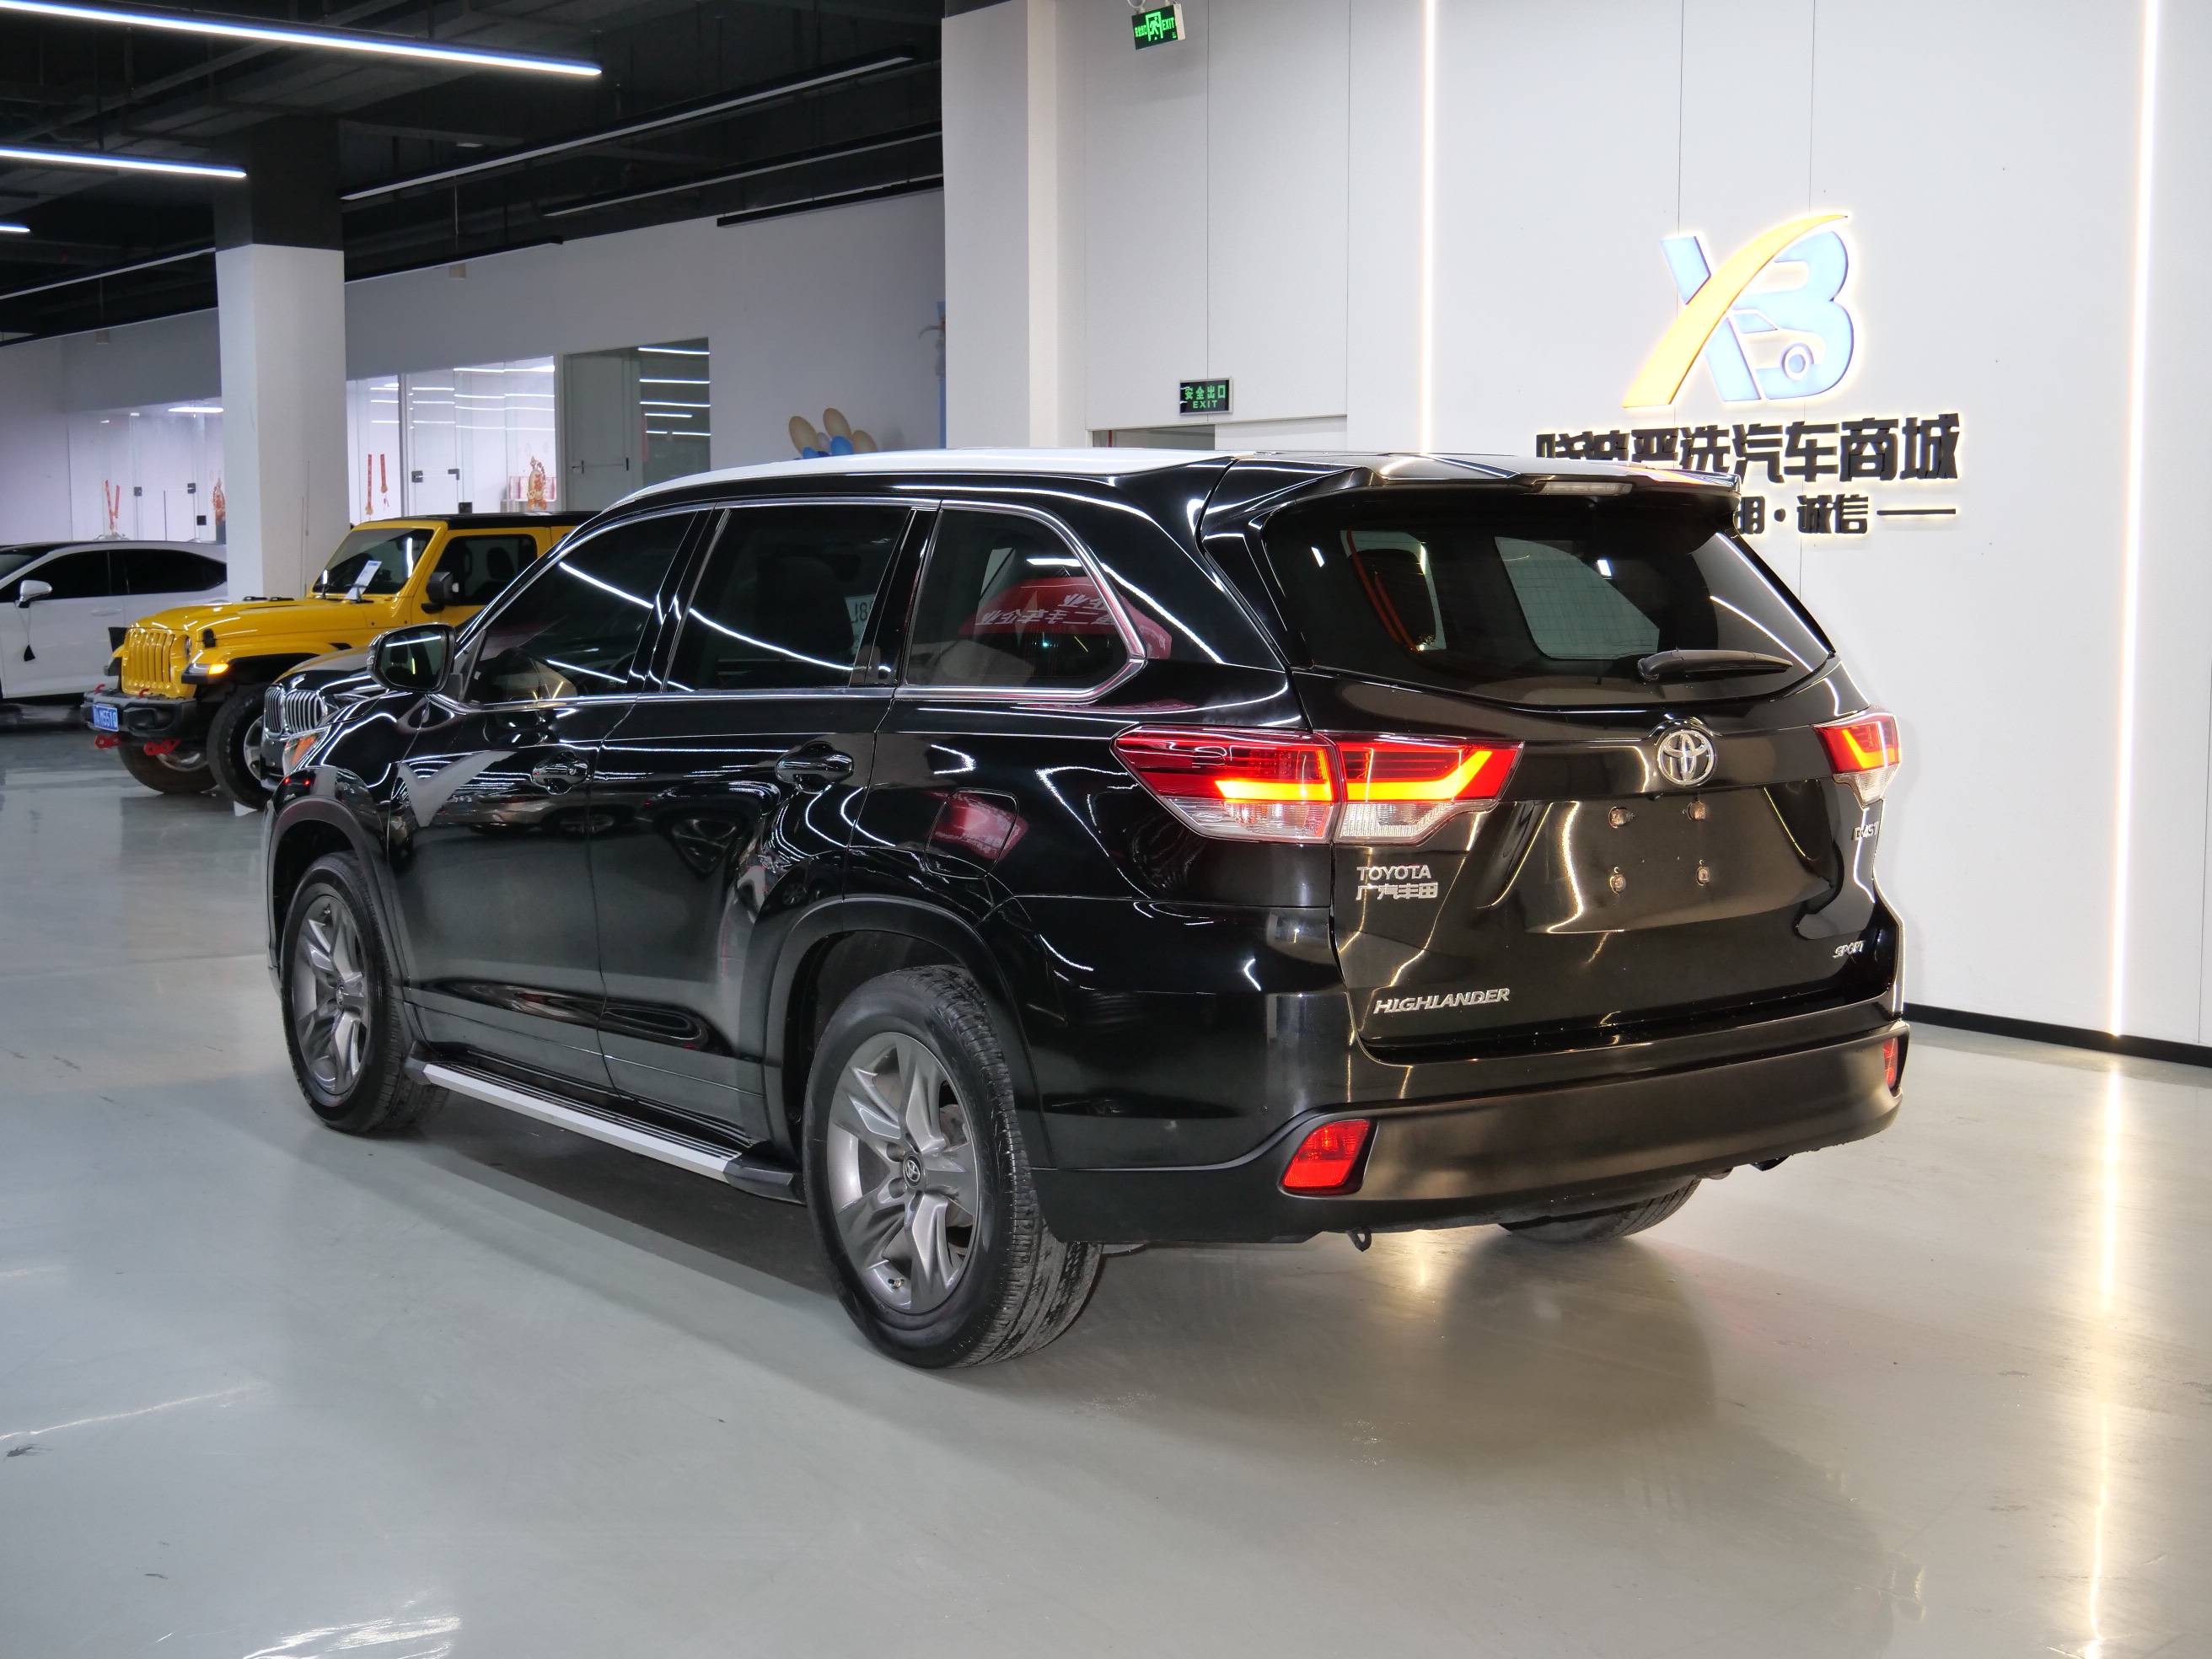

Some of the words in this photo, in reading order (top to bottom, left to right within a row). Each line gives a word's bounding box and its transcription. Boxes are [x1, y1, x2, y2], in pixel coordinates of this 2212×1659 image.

[1162, 17, 1175, 31] EXIT
[1184, 384, 1227, 400] 安全出口
[1192, 400, 1218, 409] EXIT
[1356, 864, 1432, 881] TOYOTA
[1356, 882, 1439, 901] 广汽丰田
[1833, 940, 1866, 958] SPORT
[1373, 988, 1511, 1014] HIGHLANDER
